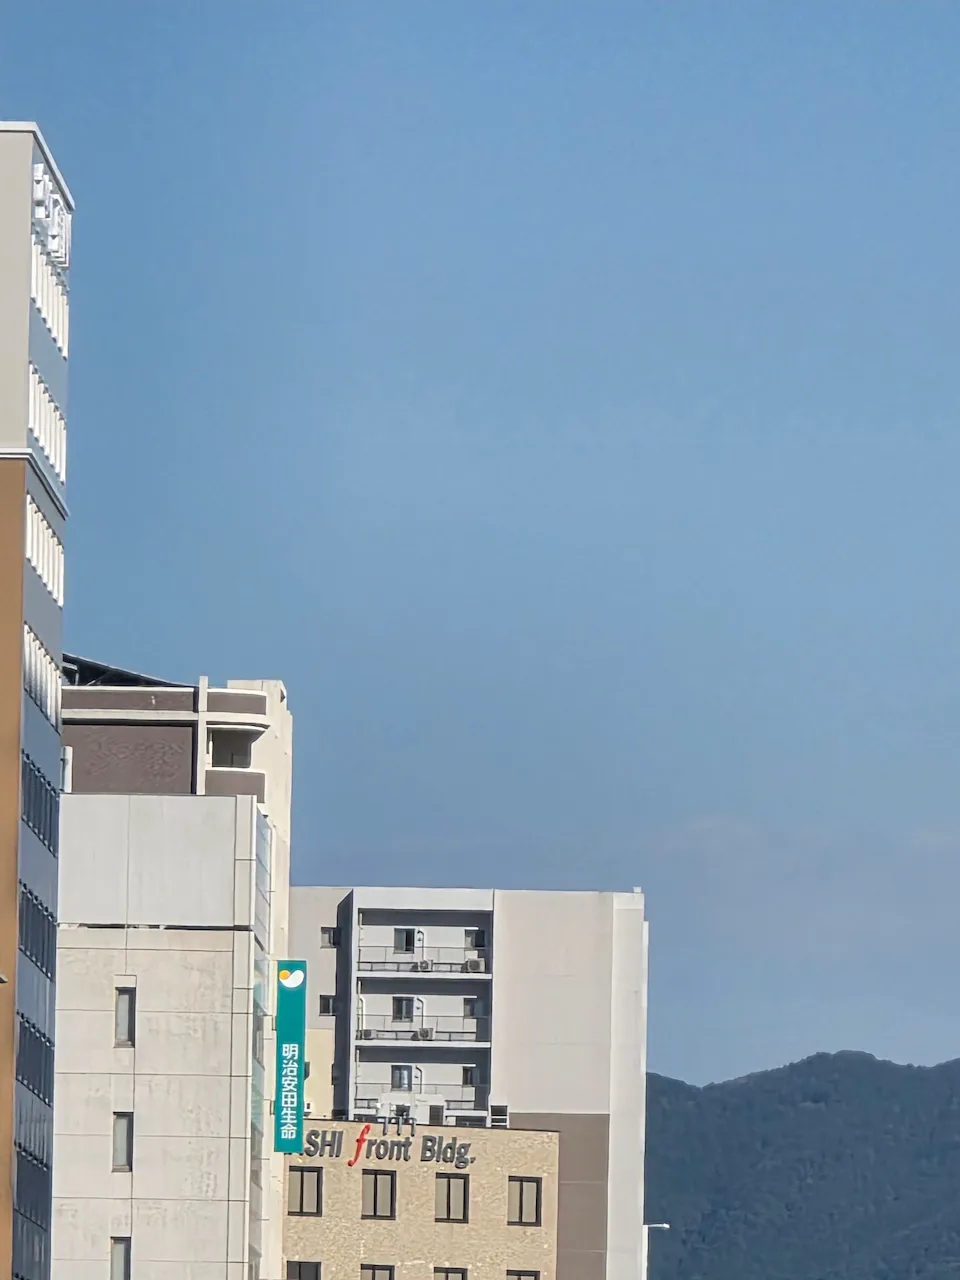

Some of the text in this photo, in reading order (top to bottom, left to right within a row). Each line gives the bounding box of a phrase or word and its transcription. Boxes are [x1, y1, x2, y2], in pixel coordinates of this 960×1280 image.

[281, 1043, 298, 1139] 明治安田生命
[292, 1124, 476, 1169] SHI front Bldg.
